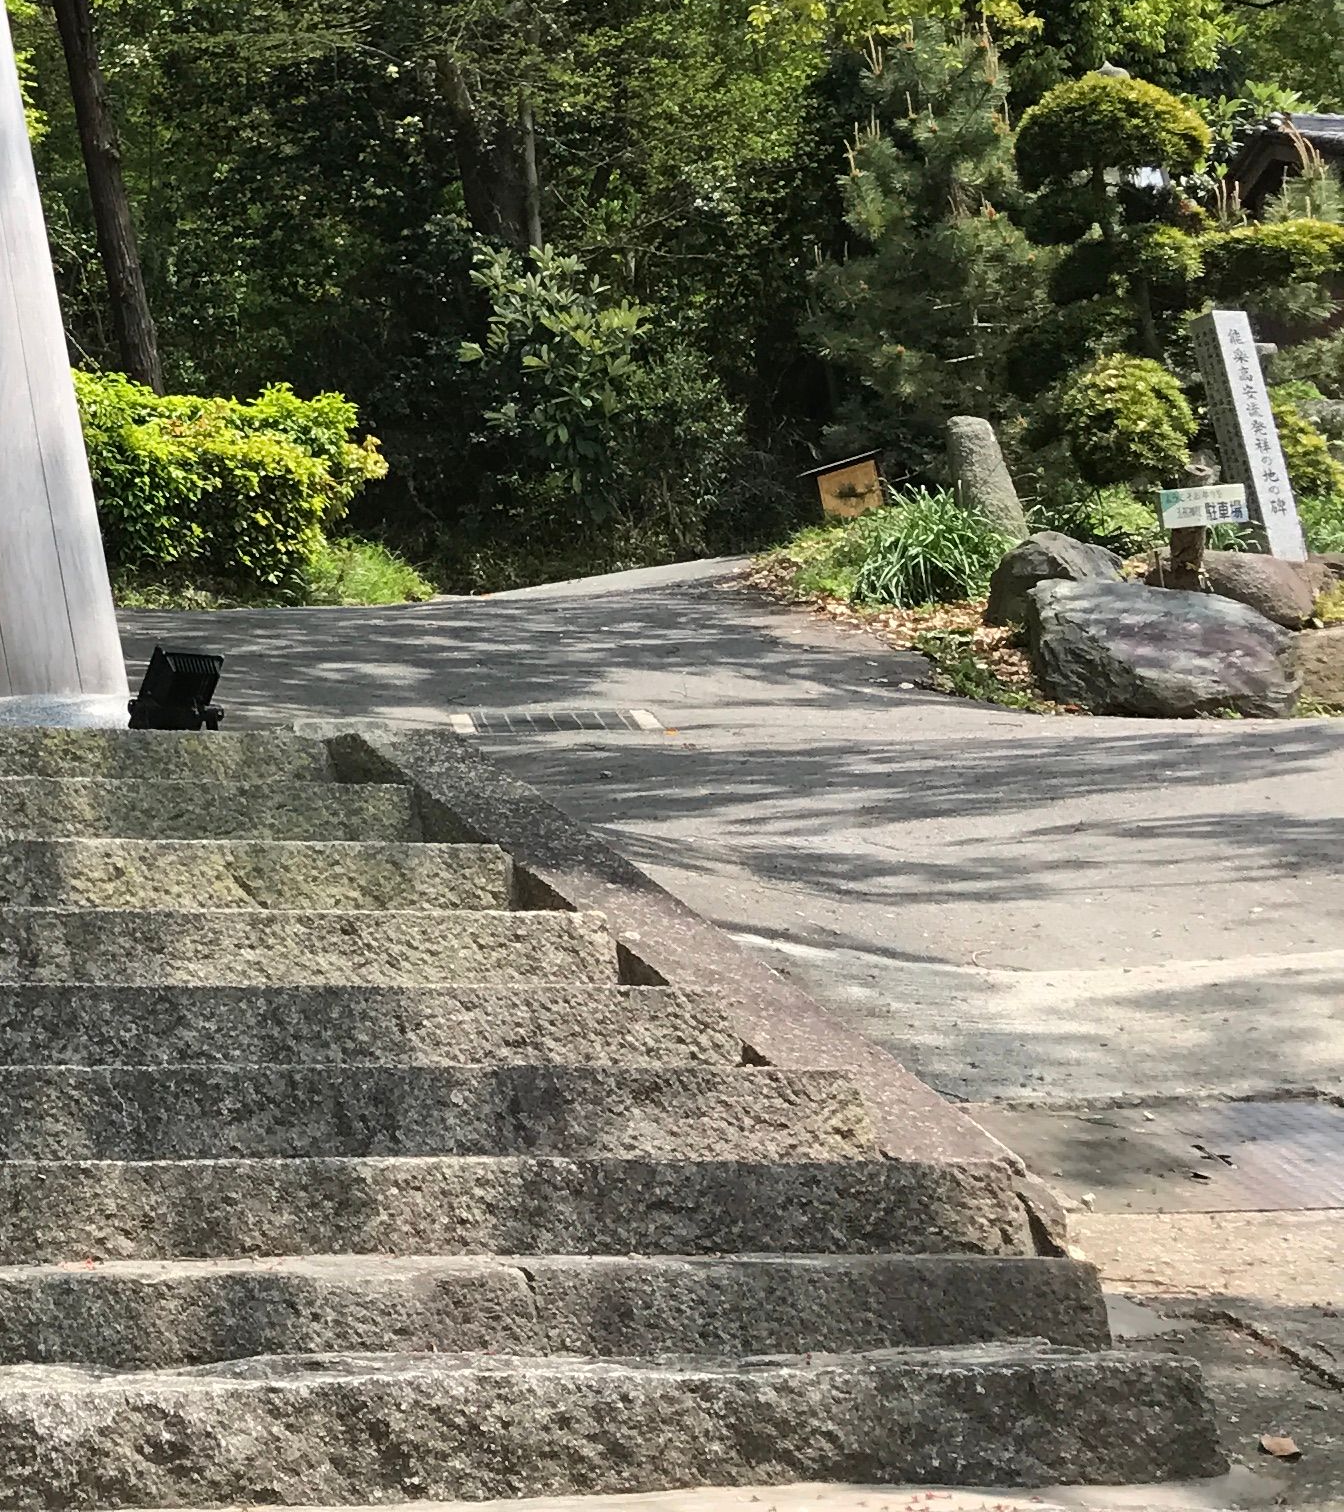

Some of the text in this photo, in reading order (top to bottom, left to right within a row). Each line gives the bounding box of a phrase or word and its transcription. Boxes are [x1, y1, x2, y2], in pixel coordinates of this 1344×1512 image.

[1227, 328, 1287, 516] 能楽高安流発祥の地の碑
